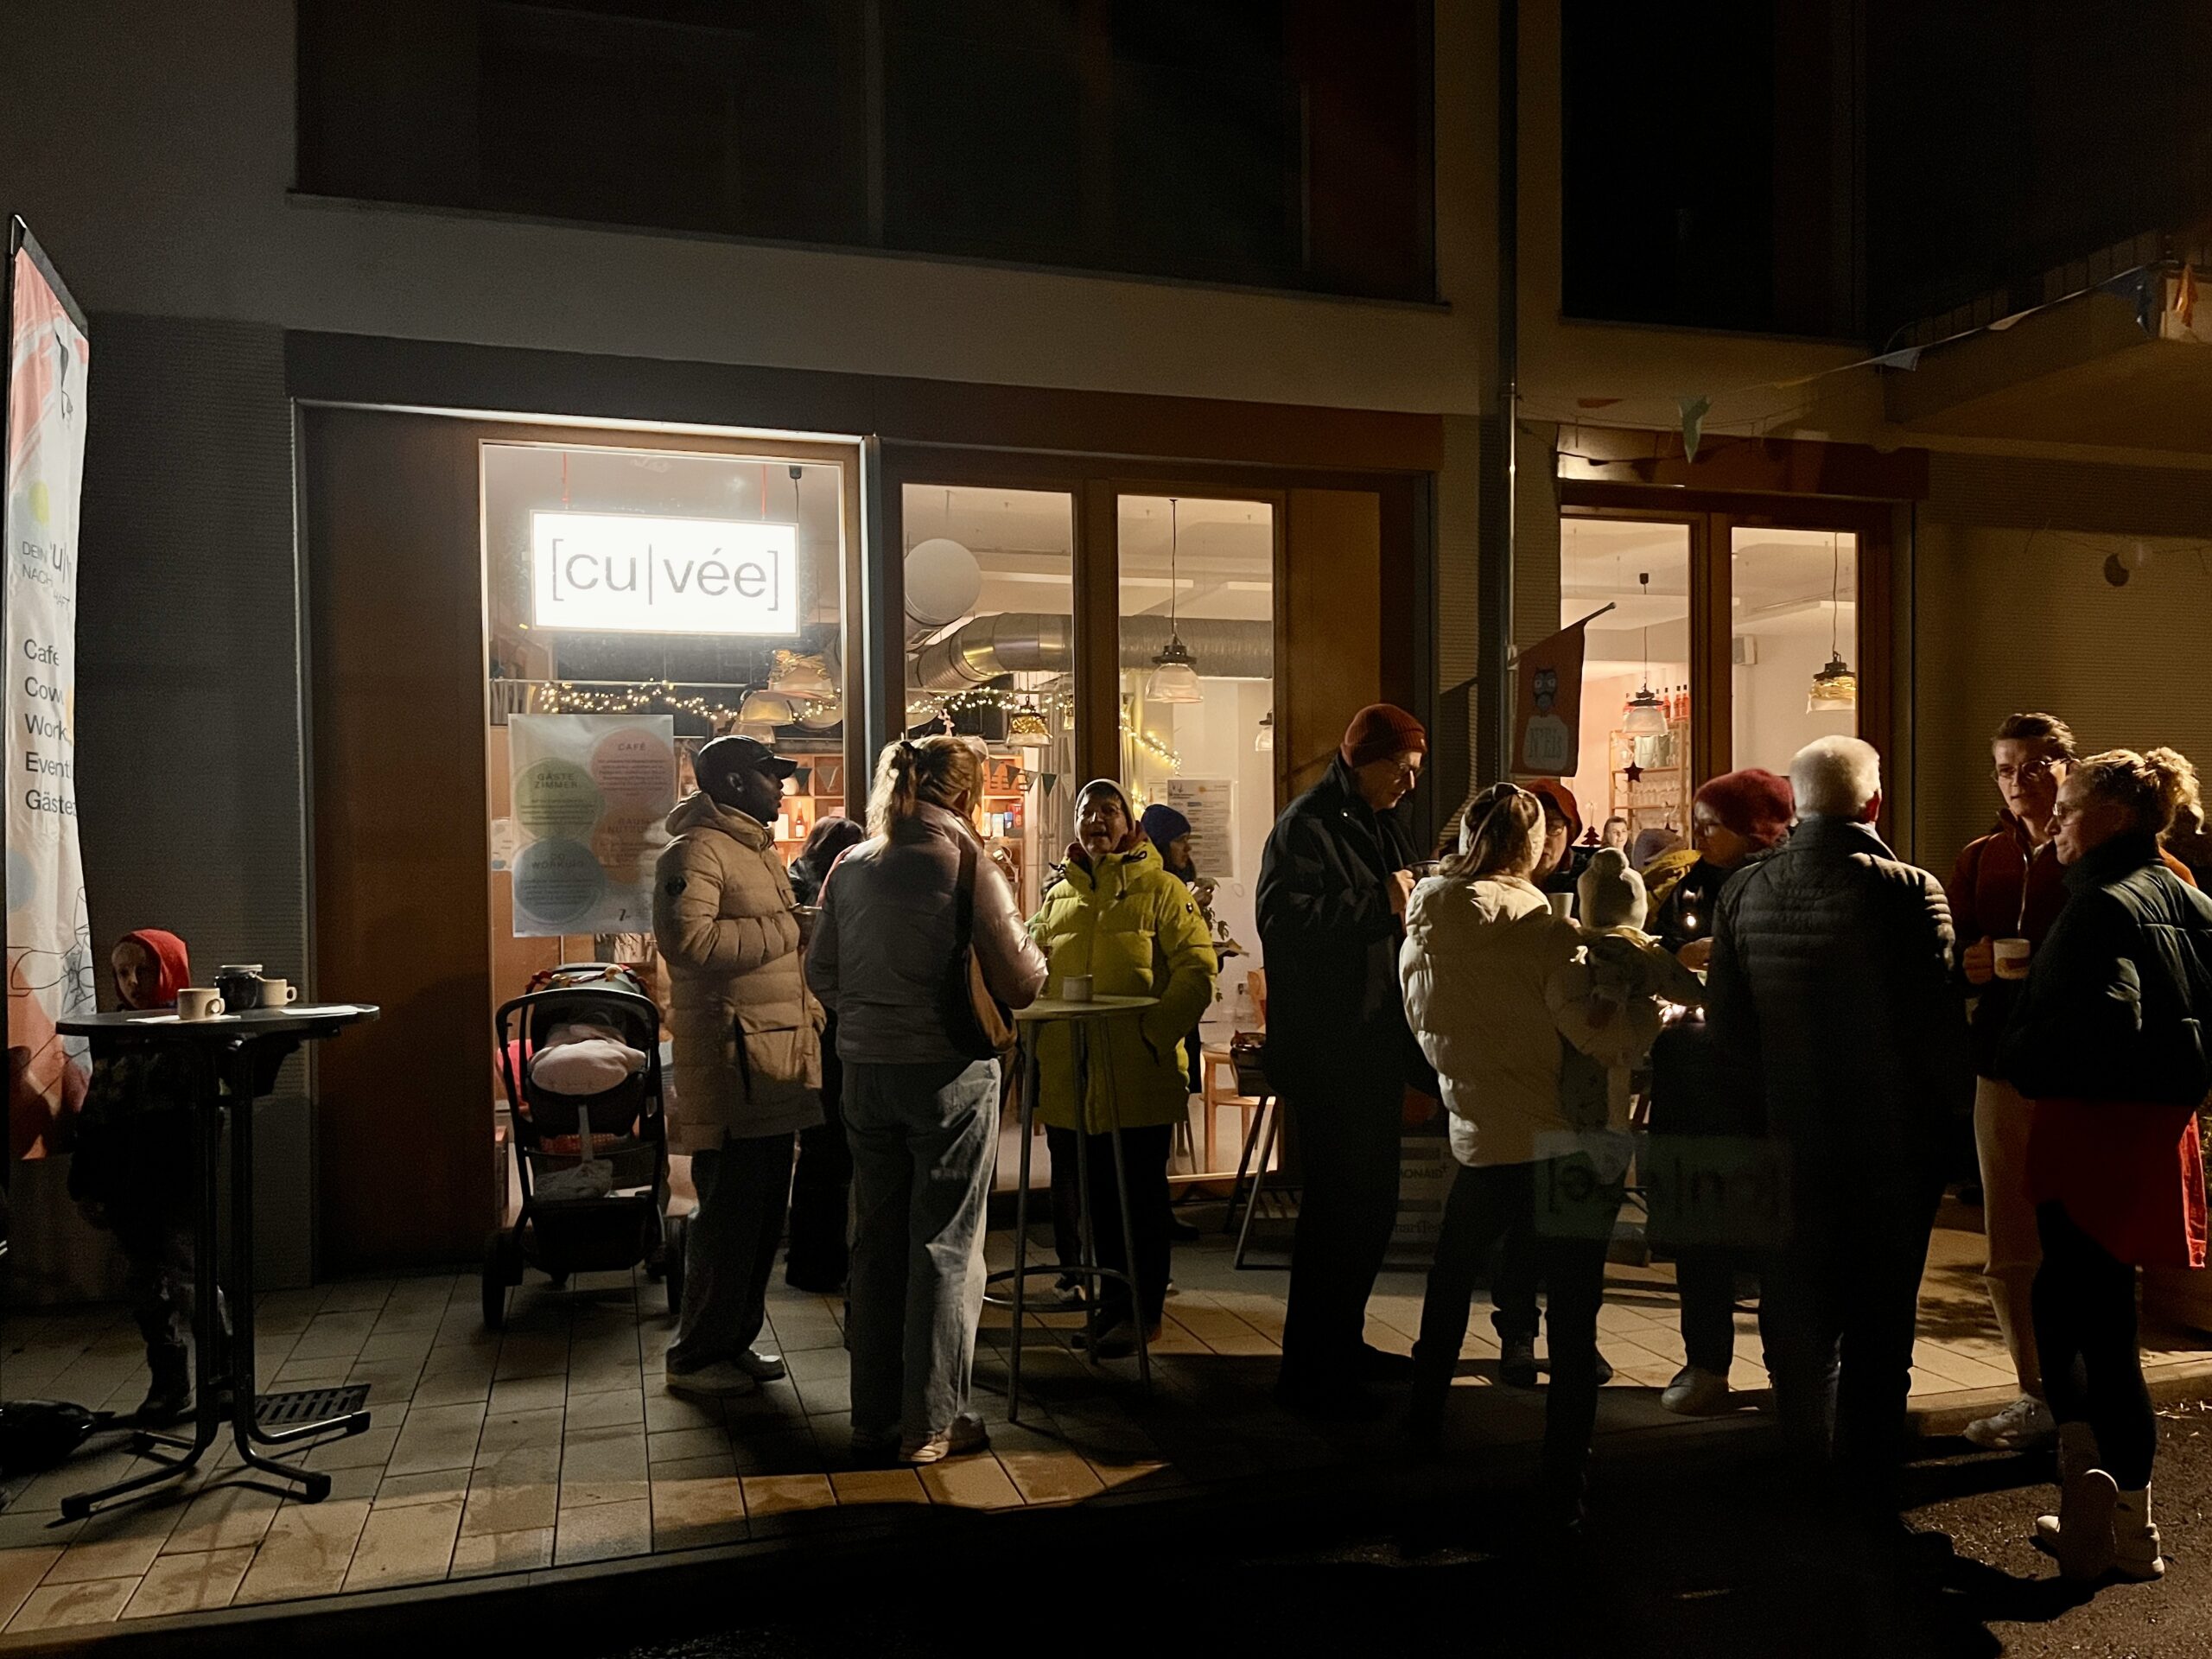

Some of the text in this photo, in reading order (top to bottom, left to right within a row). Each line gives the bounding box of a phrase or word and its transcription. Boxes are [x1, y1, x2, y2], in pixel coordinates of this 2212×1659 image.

[24, 713, 72, 747] Work
[25, 750, 73, 779] Event
[534, 780, 578, 789] ZIMMER
